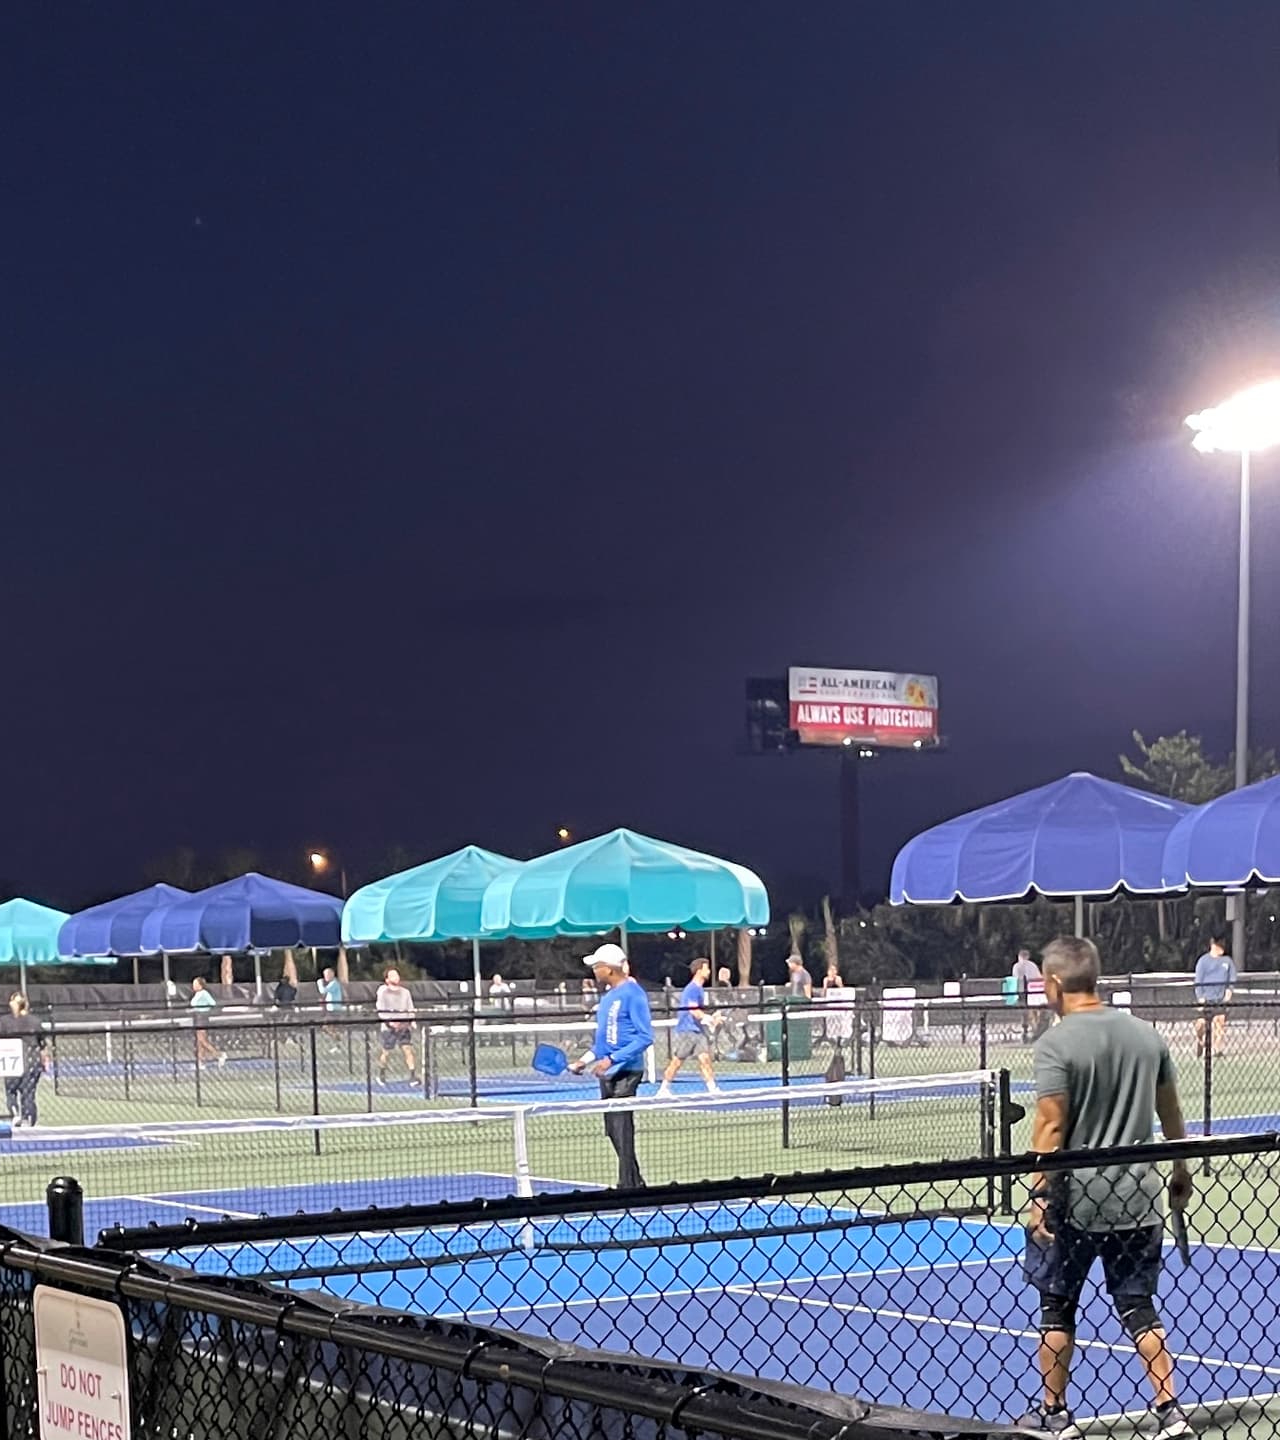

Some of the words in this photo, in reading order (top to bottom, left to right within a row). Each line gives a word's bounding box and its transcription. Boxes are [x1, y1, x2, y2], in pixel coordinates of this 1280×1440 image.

[821, 677, 896, 691] ALL-AMERICAN
[797, 704, 840, 724] ALWAYS
[843, 706, 864, 725] USE
[868, 707, 932, 728] PROTECTION
[0, 1056, 20, 1070] 17
[60, 1363, 76, 1391] DO
[79, 1369, 102, 1400] NOT
[46, 1401, 74, 1431] JUMP
